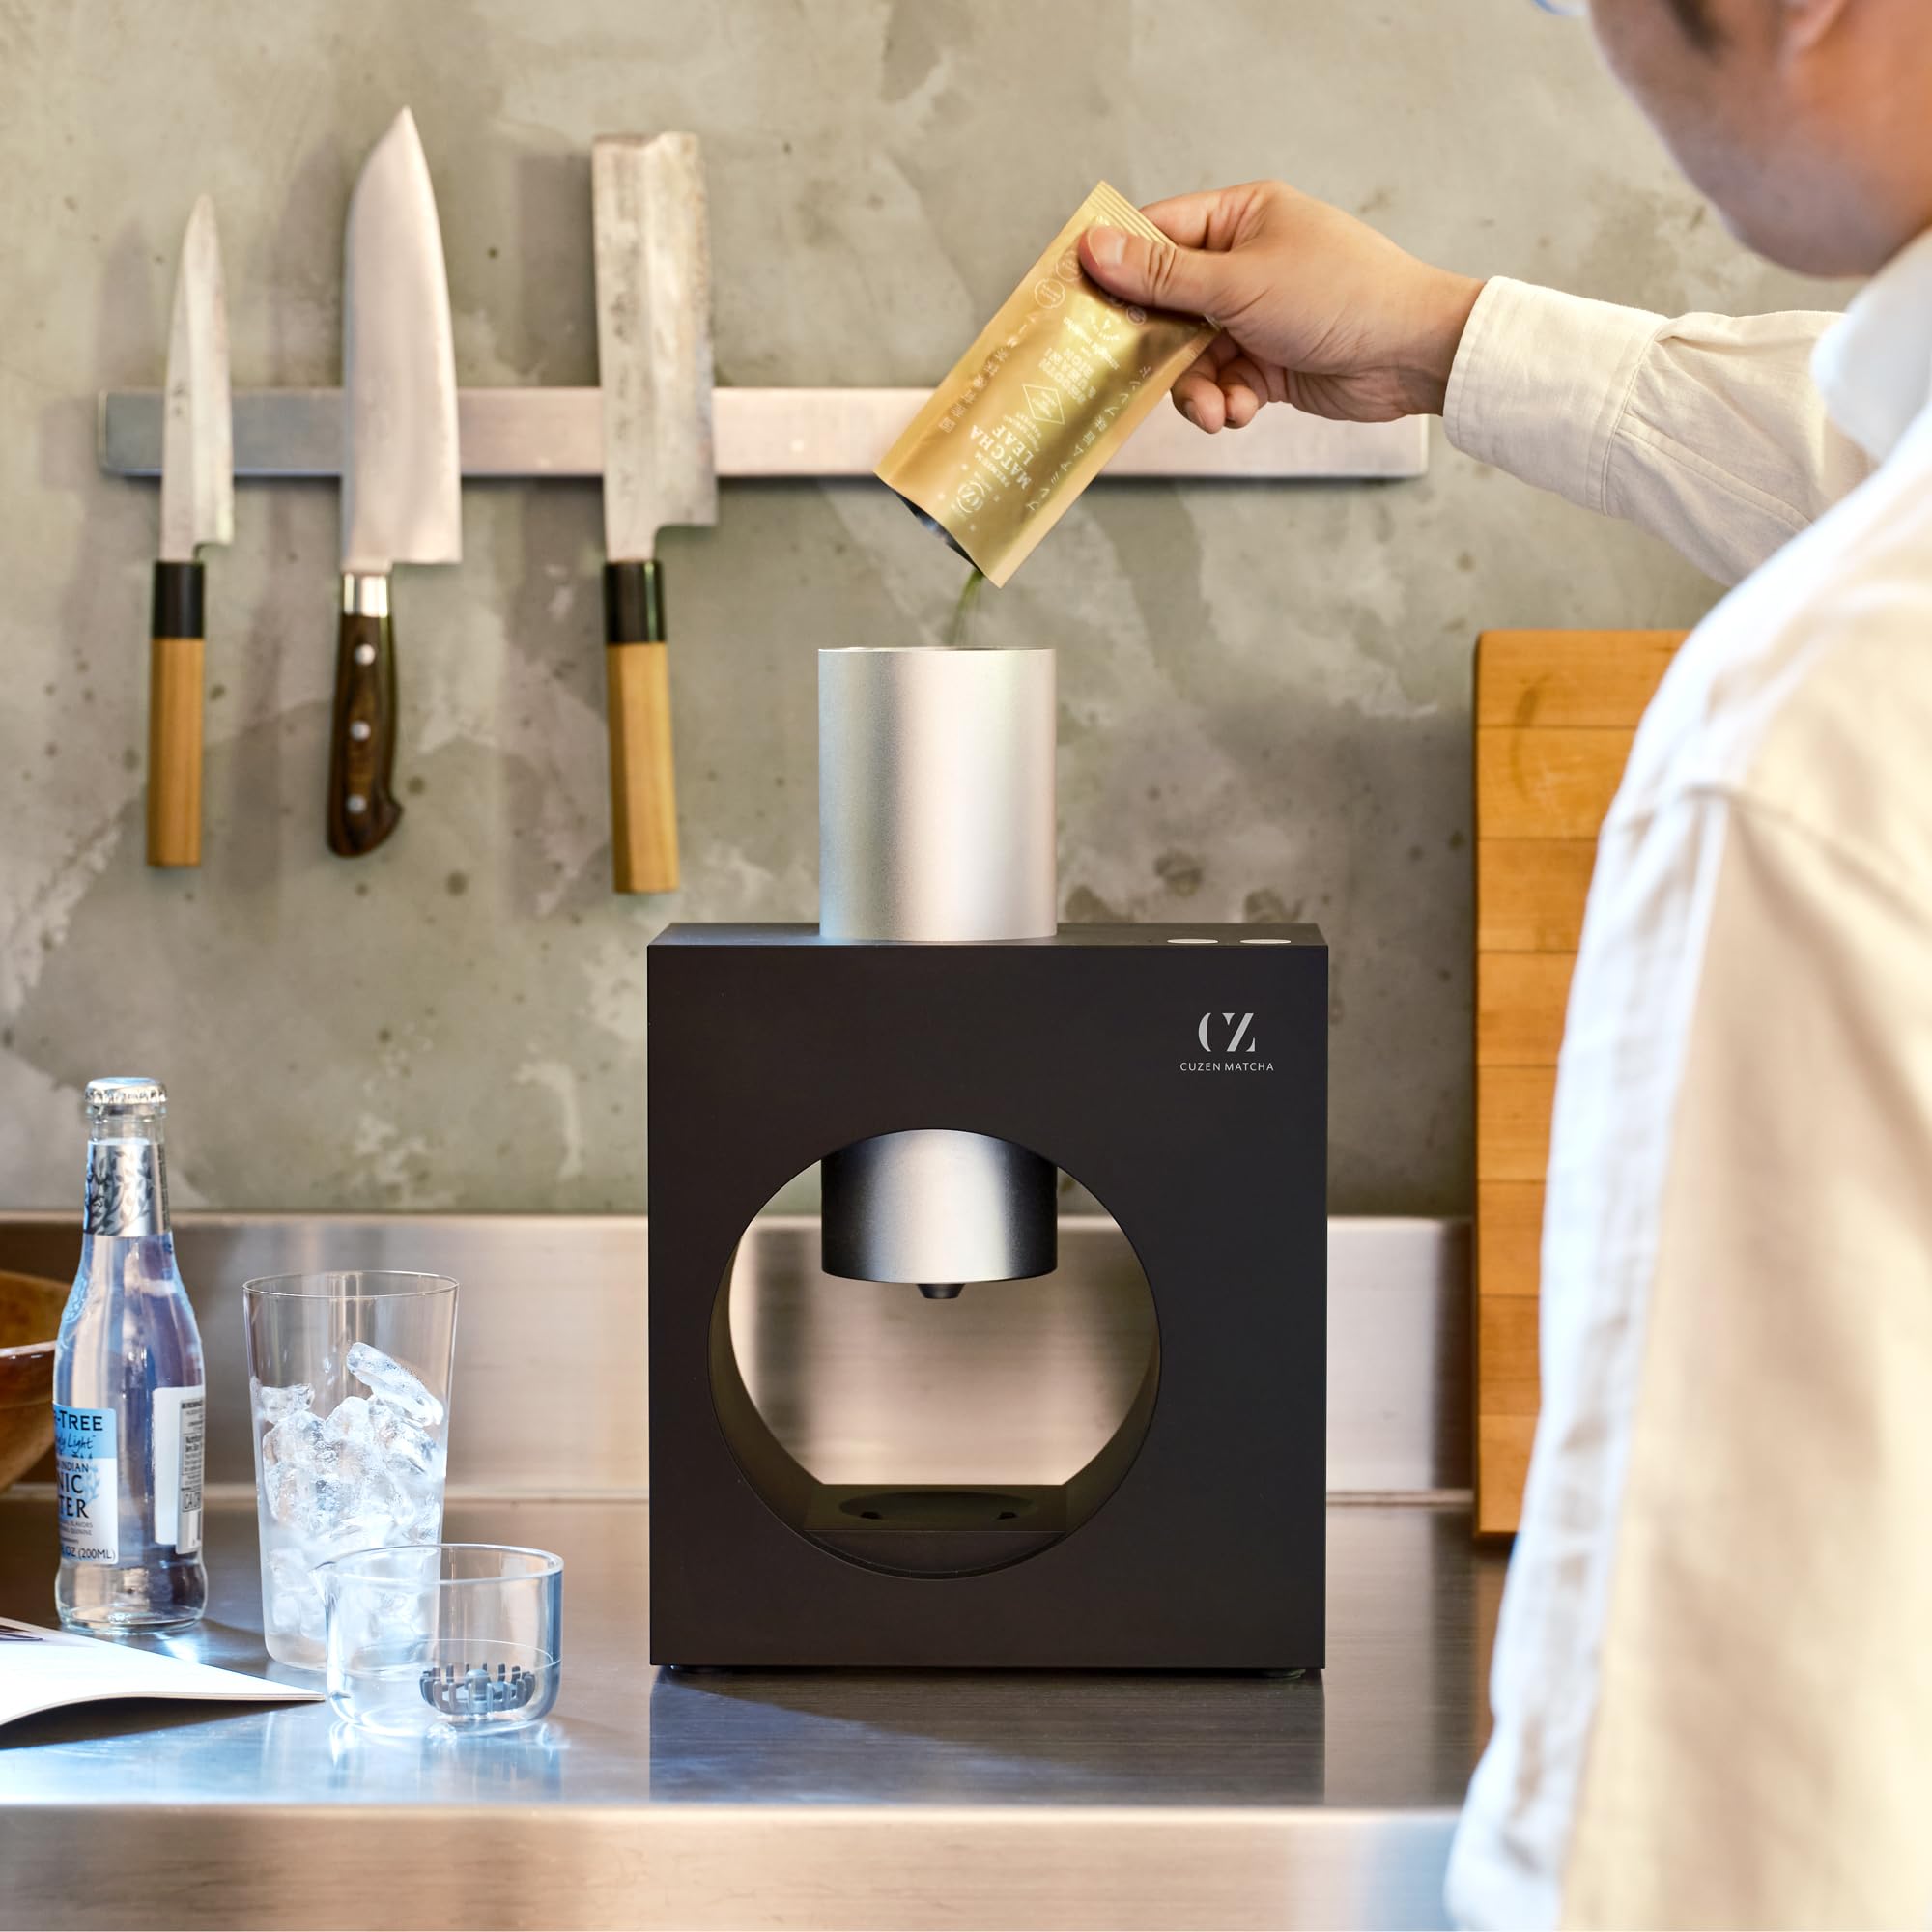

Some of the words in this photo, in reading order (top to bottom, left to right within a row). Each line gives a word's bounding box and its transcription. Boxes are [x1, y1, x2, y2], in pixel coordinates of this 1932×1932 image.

[969, 423, 1032, 490] MATCHA
[990, 424, 1035, 466] LEAF
[1198, 1012, 1256, 1052] CZ
[1179, 1062, 1221, 1072] CUZEN
[1224, 1062, 1274, 1072] MATCHA
[54, 1409, 103, 1431] -TREE
[57, 1471, 83, 1494] NIC
[59, 1494, 90, 1519] TER
[78, 1548, 116, 1562] (200ML)
